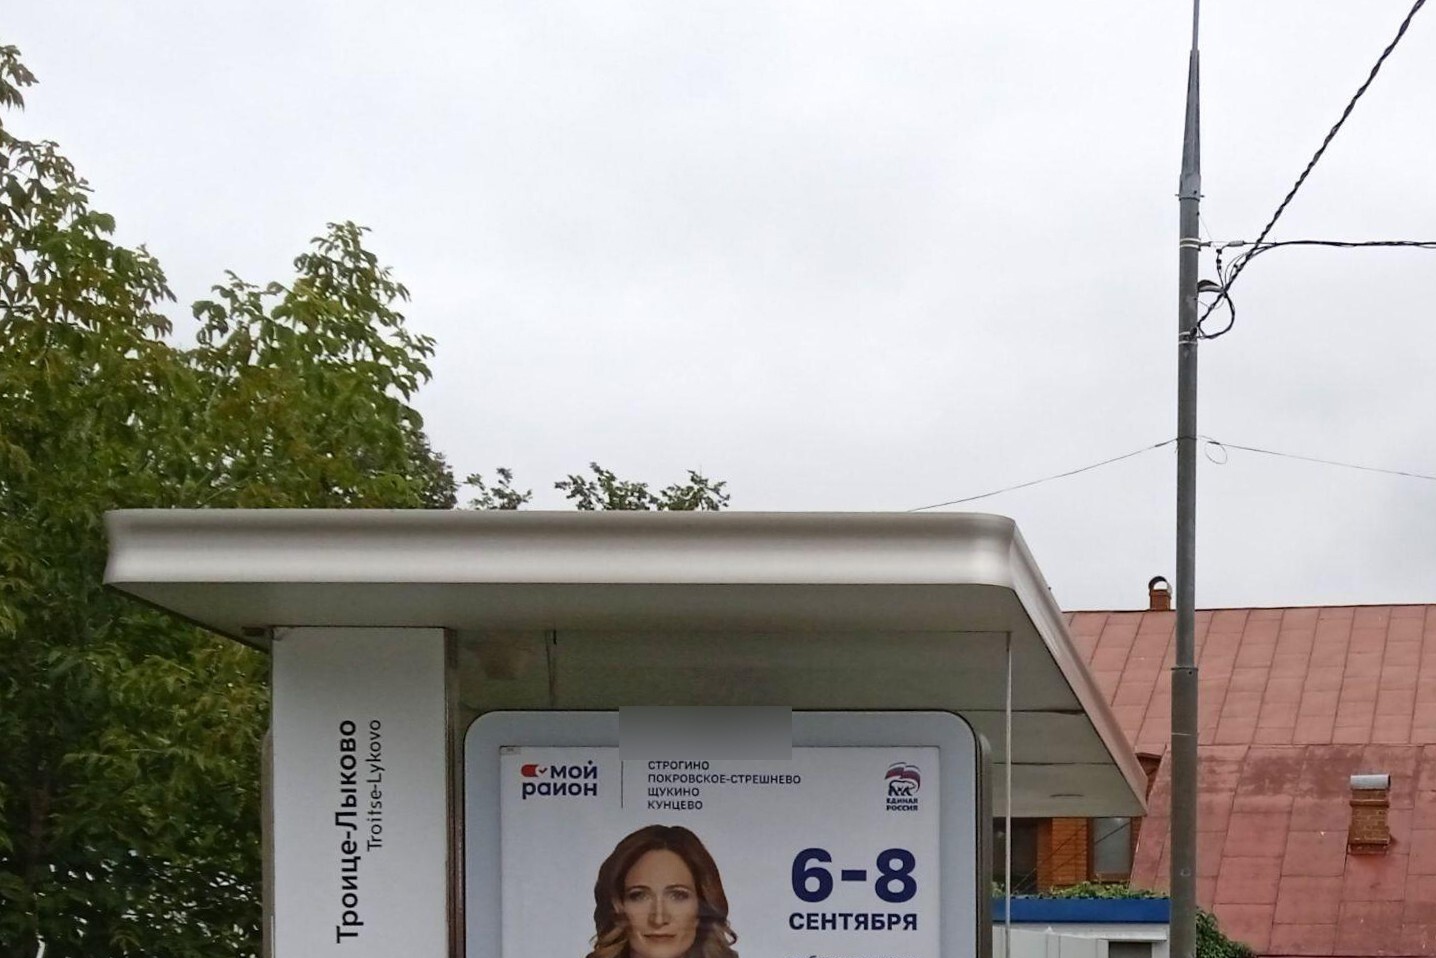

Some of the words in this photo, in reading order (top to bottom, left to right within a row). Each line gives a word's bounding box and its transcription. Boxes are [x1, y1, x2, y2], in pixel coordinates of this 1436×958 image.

[648, 761, 710, 770] СТРОГИНО
[648, 774, 801, 784] ПОКРОВСКОЕ-СТРЕШНЕВО
[365, 719, 386, 851] Troitse-Lykovo
[648, 787, 700, 798] ЩУКИНО
[648, 800, 703, 811] КУНЦЕВО
[335, 720, 363, 943] Троице-Лыково
[789, 912, 917, 930] СЕНТЯБРЯ
